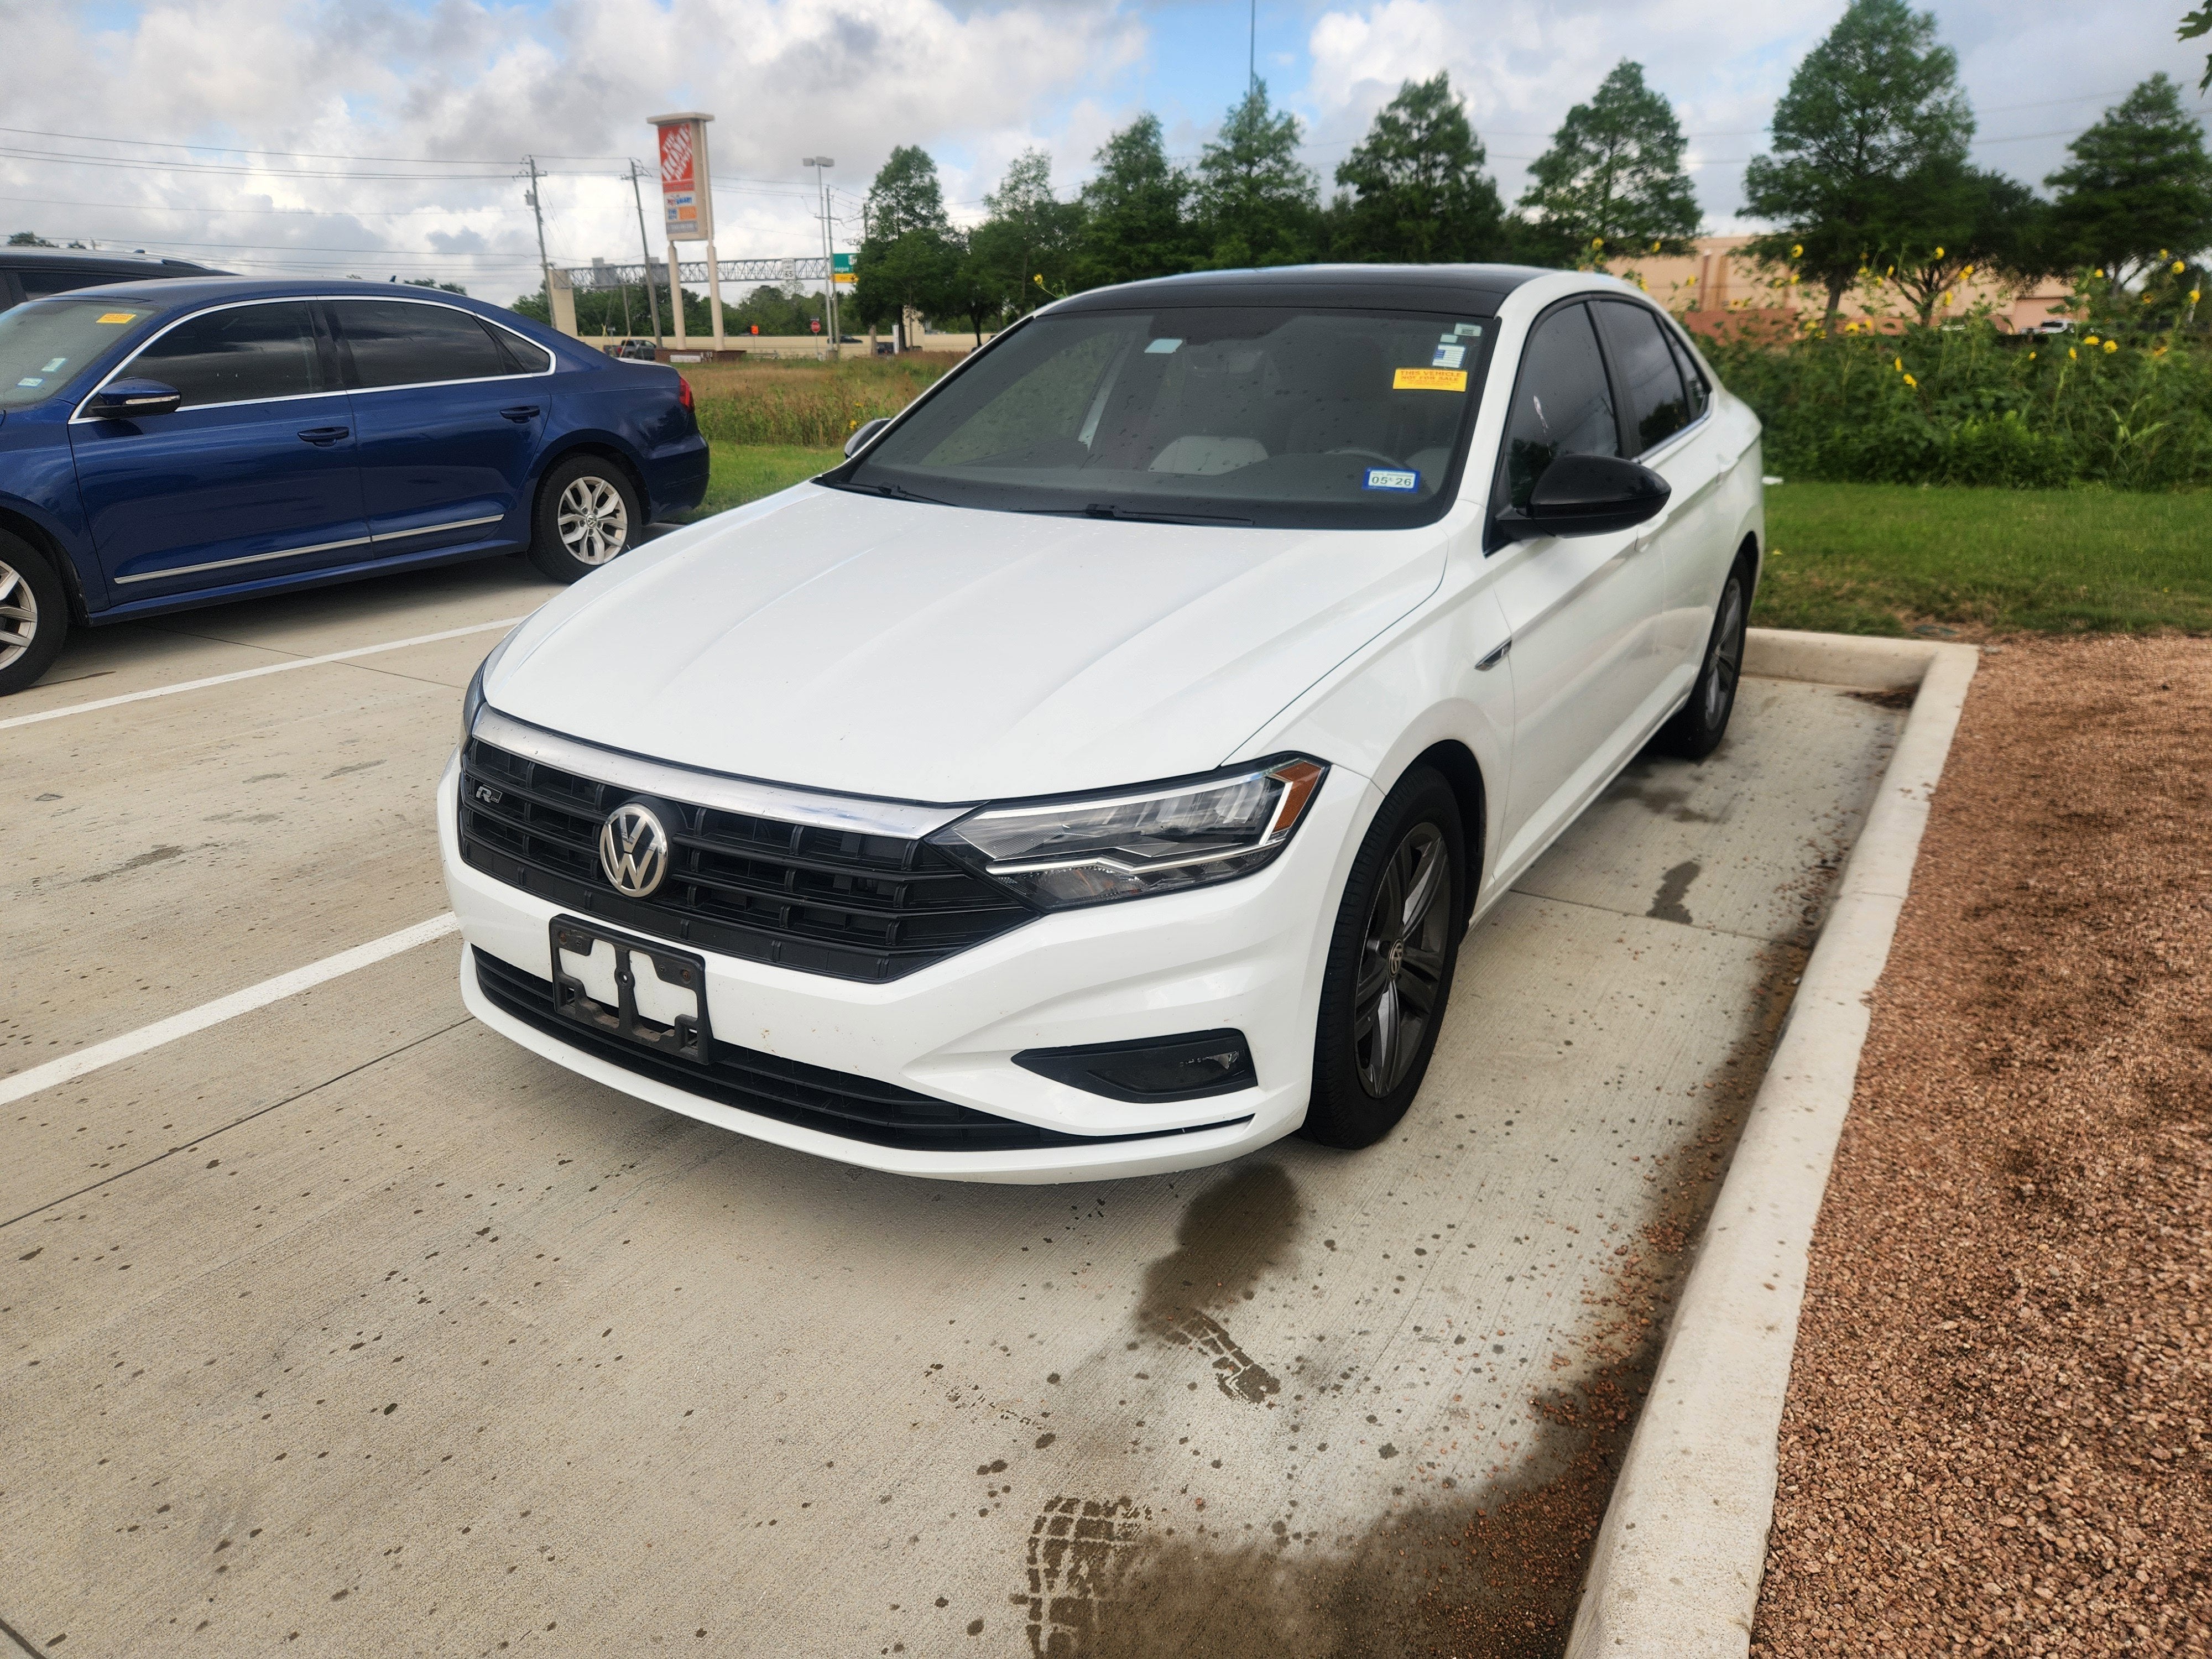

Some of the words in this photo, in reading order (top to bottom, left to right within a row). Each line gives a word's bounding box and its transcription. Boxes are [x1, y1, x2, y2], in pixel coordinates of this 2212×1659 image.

[1372, 476, 1387, 484] 05
[1395, 478, 1411, 486] 26
[476, 786, 492, 803] R
